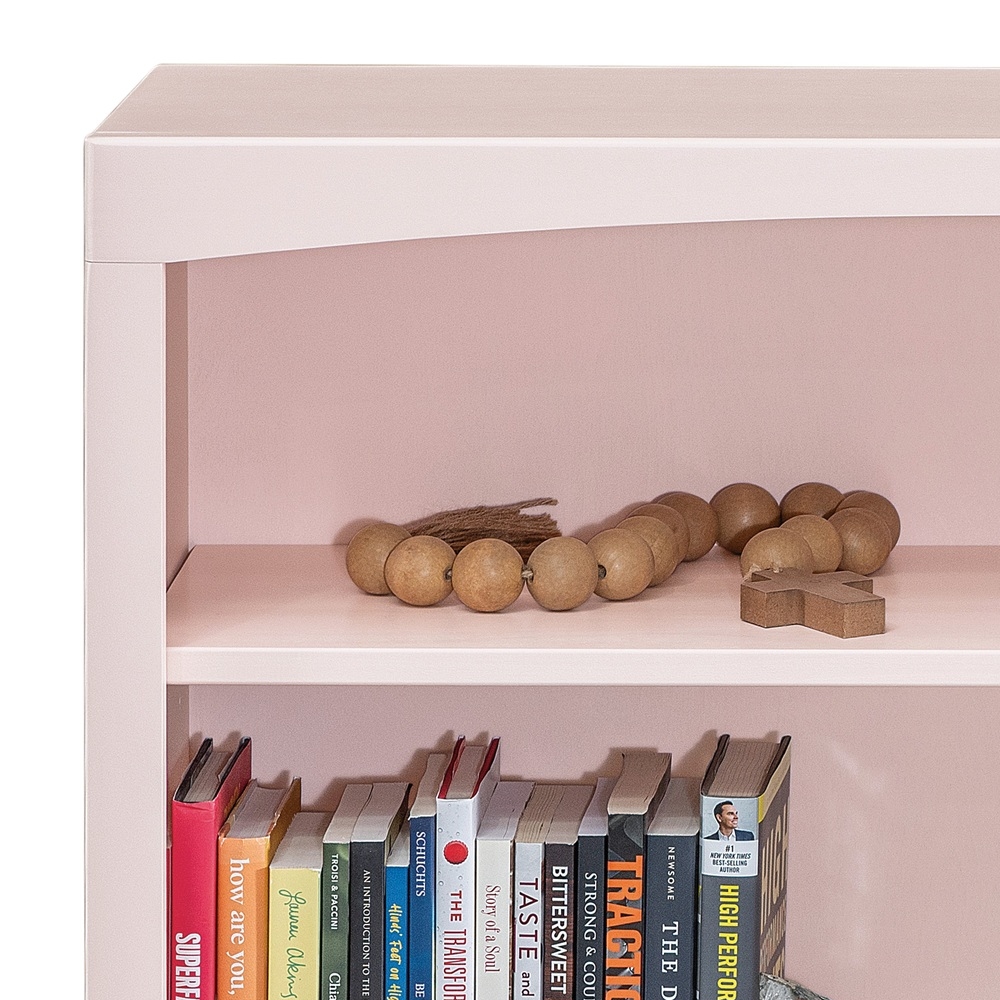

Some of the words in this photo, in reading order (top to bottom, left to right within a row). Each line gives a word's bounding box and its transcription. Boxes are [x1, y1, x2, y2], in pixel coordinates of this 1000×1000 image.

[330, 854, 339, 883] TROISI
[363, 869, 371, 883] AN
[415, 831, 427, 897] SCHUCHTS
[667, 846, 676, 901] NEWSOME
[229, 858, 250, 905] how
[279, 889, 306, 941] Lauren
[330, 894, 339, 930] PACCINI
[450, 890, 463, 922] THE
[481, 885, 502, 917] Story
[584, 872, 598, 941] STRONG
[718, 884, 740, 927] HIGH
[230, 910, 245, 945] are
[361, 885, 371, 960] INTRODUCTION
[484, 920, 500, 933] of
[518, 877, 539, 960] TASTE
[550, 866, 569, 995] BITTERSWEET
[484, 933, 496, 943] a
[585, 946, 597, 957] &
[661, 921, 679, 973] THE
[226, 951, 245, 995] you,
[362, 962, 370, 976] TO
[389, 967, 399, 981] on
[484, 945, 501, 973] Soul
[362, 978, 370, 997] THE
[414, 983, 425, 998] BE
[521, 971, 535, 997] and
